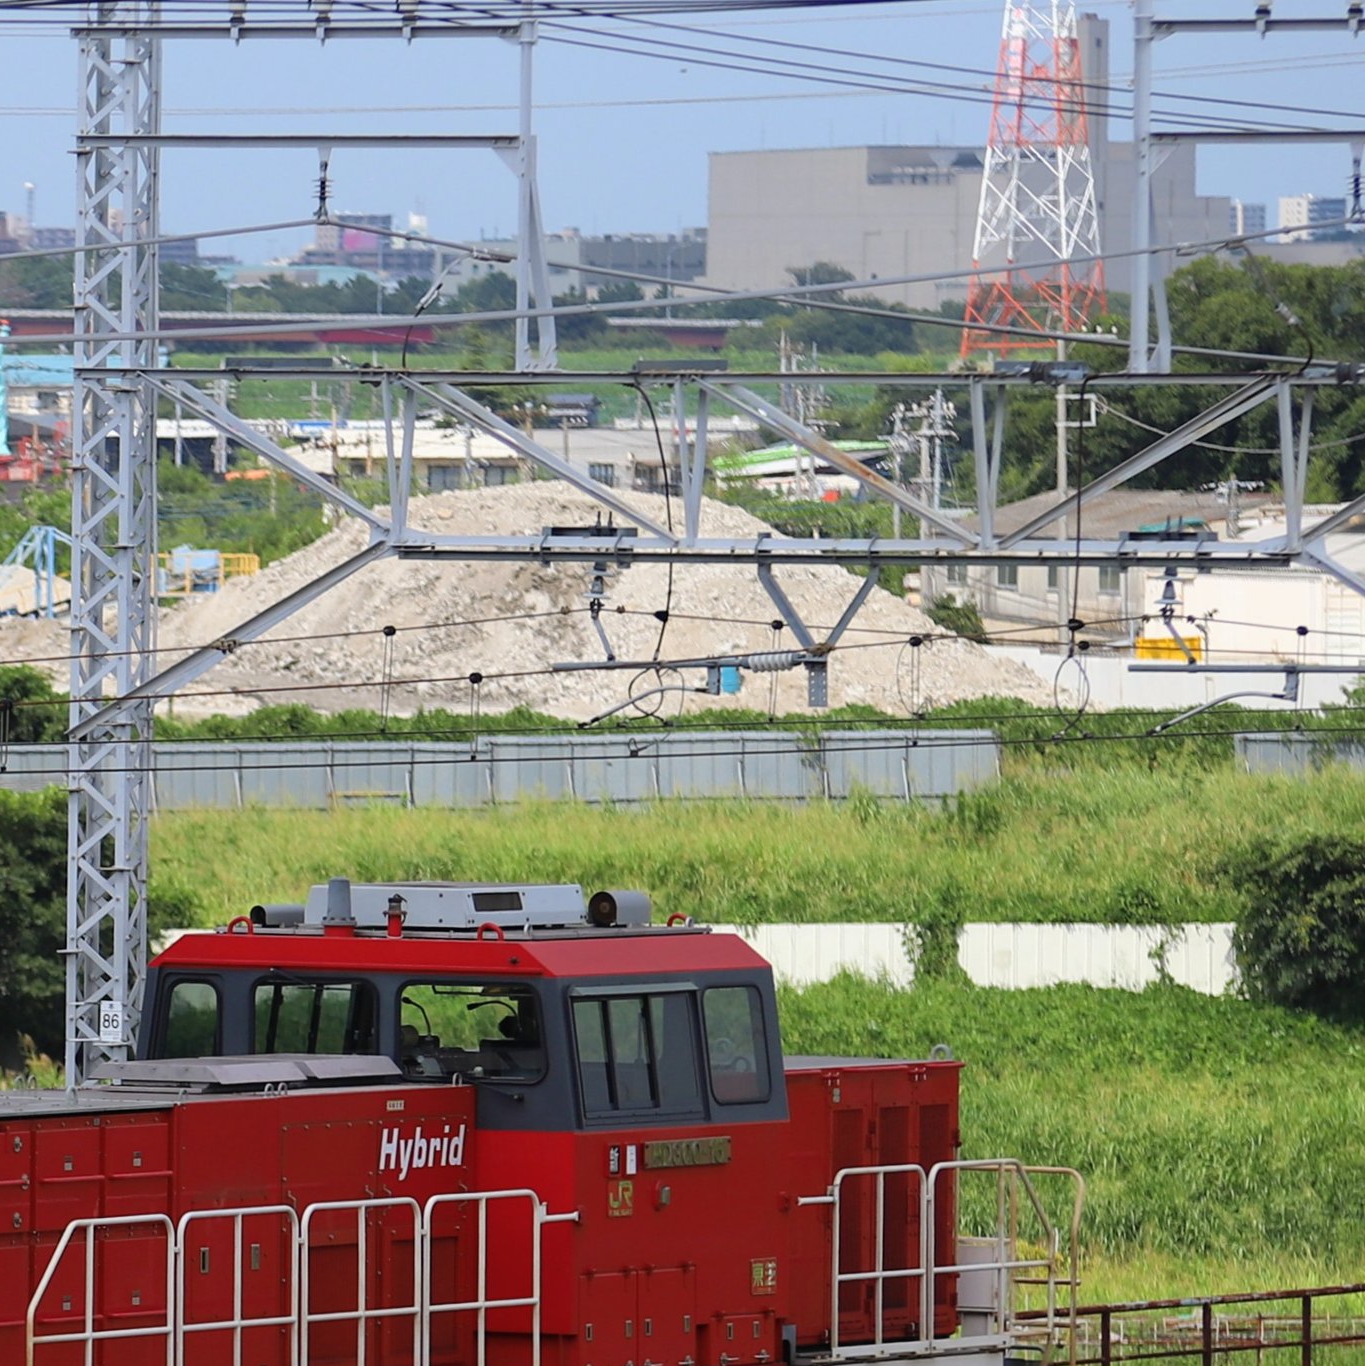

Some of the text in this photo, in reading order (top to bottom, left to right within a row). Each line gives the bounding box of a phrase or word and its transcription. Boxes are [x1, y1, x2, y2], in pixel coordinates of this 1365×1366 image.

[102, 1013, 119, 1029] 86
[379, 1124, 466, 1181] Hybrid
[610, 1180, 633, 1208] JR
